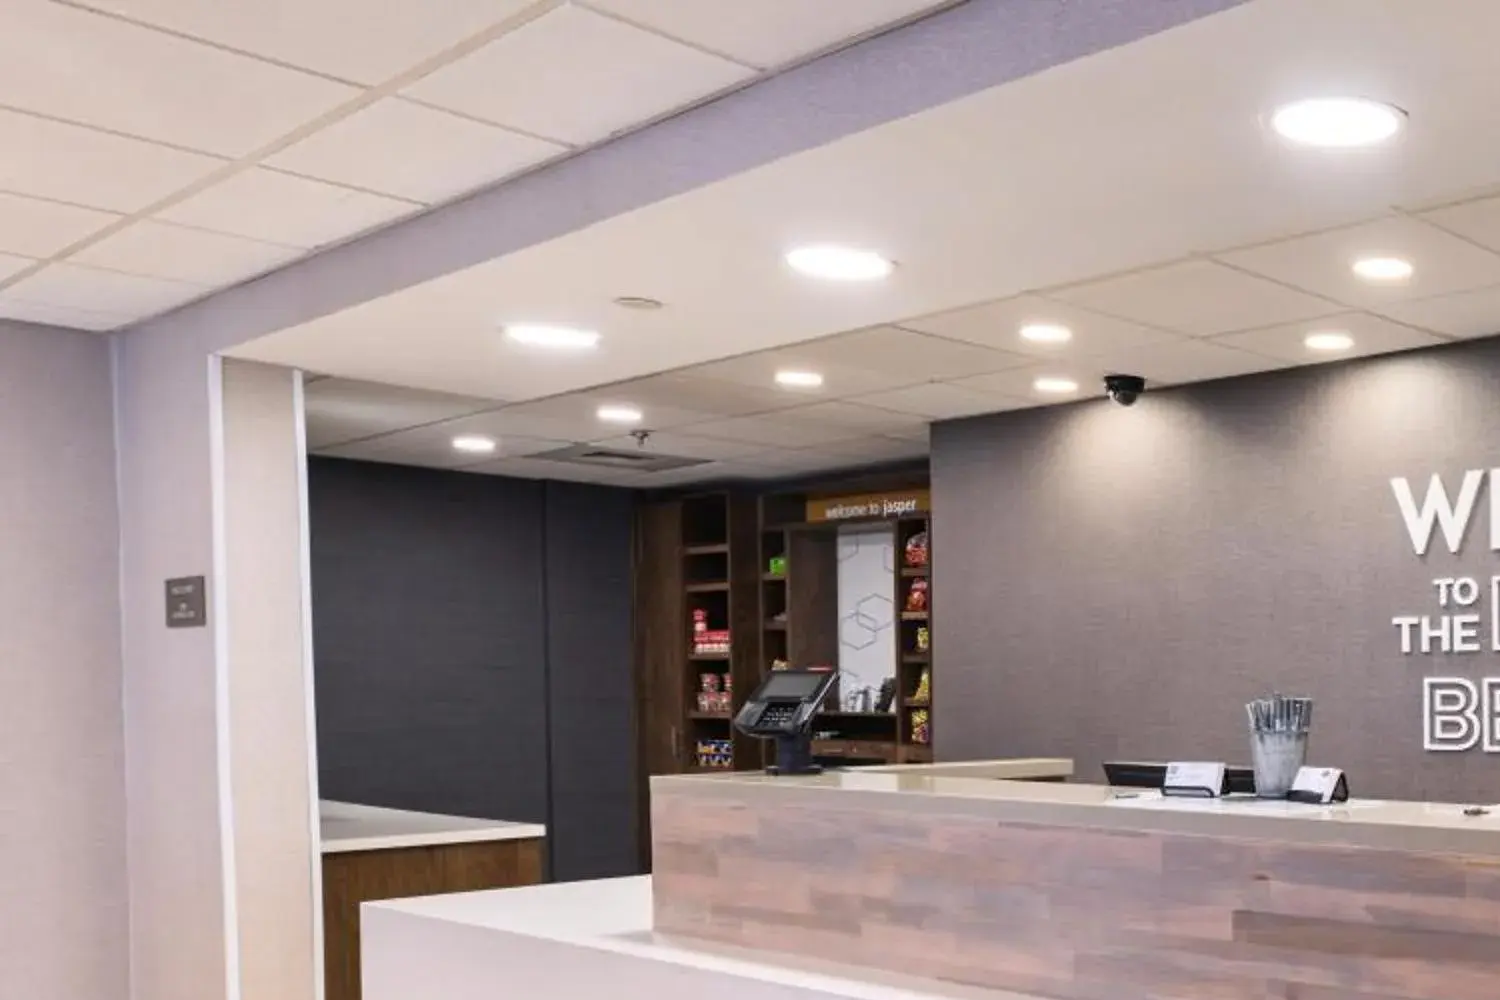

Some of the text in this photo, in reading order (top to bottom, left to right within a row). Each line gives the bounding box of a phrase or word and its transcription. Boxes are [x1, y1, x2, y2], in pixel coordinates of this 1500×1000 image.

[825, 499, 916, 518] welcome to jasper
[1432, 577, 1479, 606] TO
[1391, 614, 1480, 652] THE
